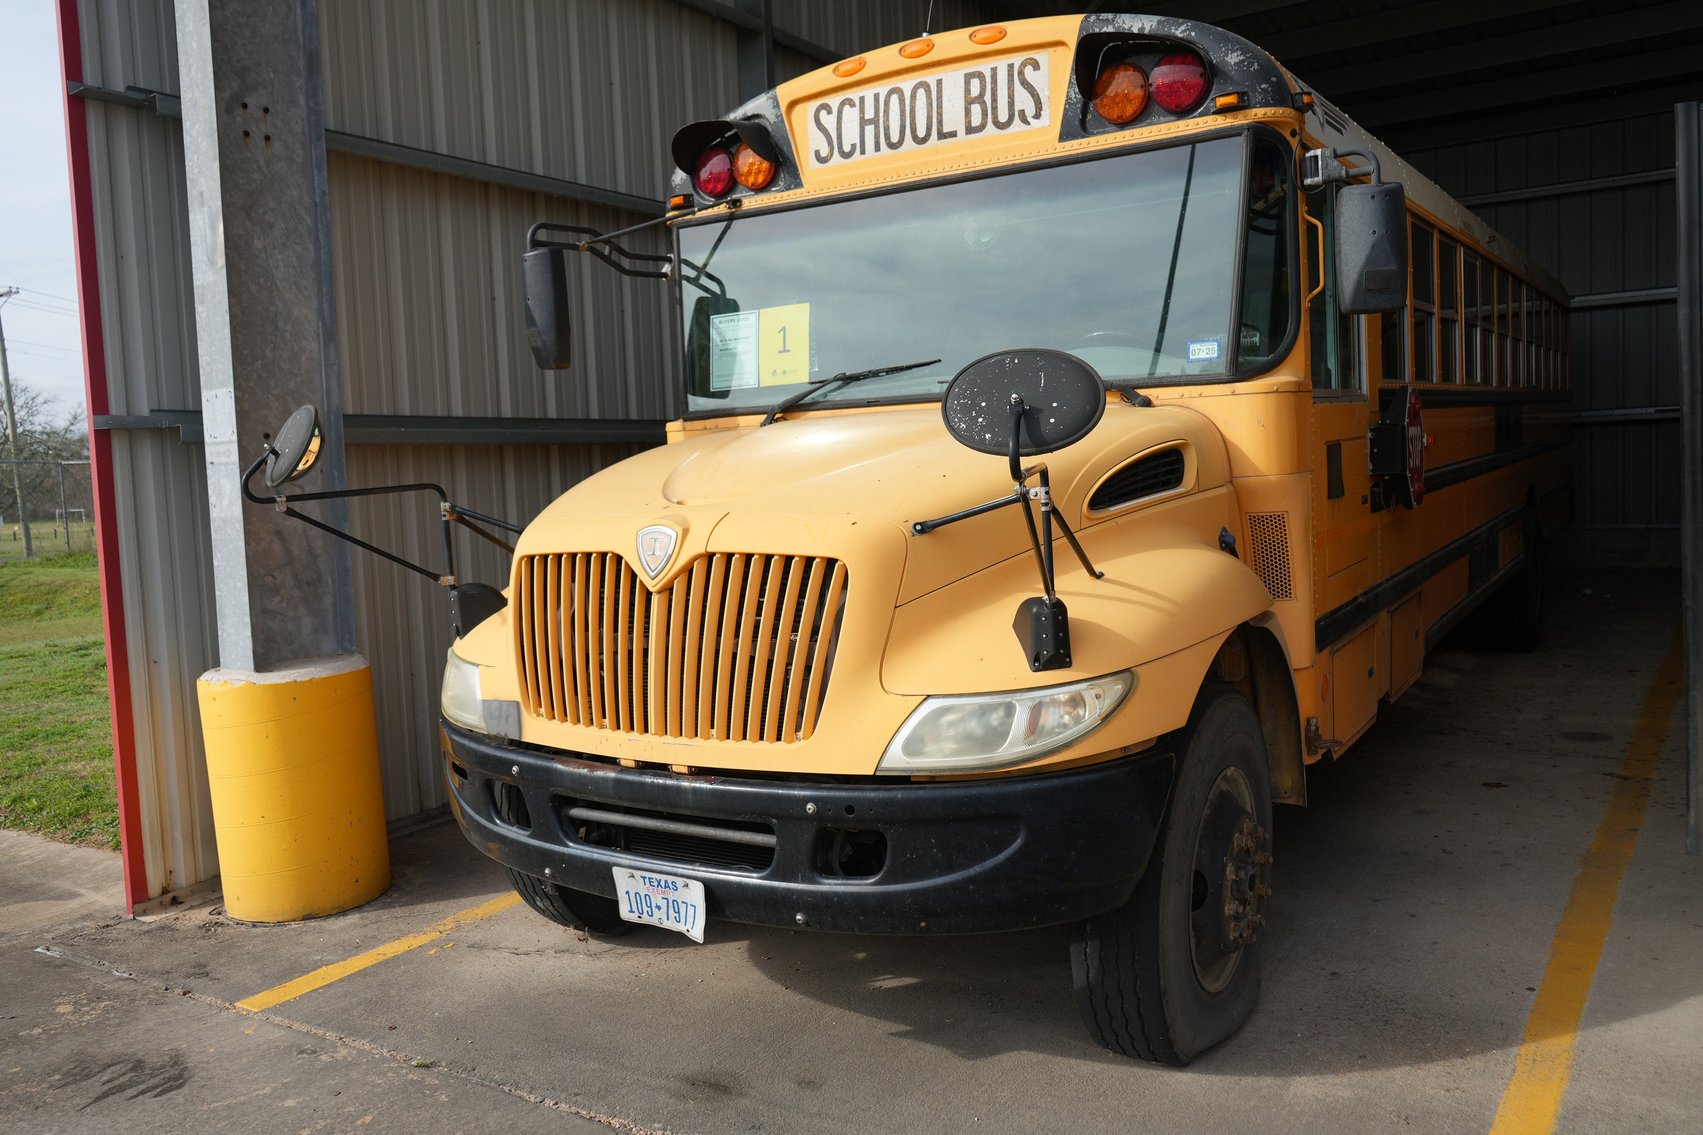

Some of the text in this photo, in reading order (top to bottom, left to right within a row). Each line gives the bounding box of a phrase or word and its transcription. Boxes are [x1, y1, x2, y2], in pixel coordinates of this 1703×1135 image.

[813, 57, 1043, 164] SCHOOL BUS
[777, 325, 791, 354] 1
[640, 876, 678, 891] TEXAS
[646, 886, 676, 897] EXEMPT
[625, 890, 697, 930] 109 7977
